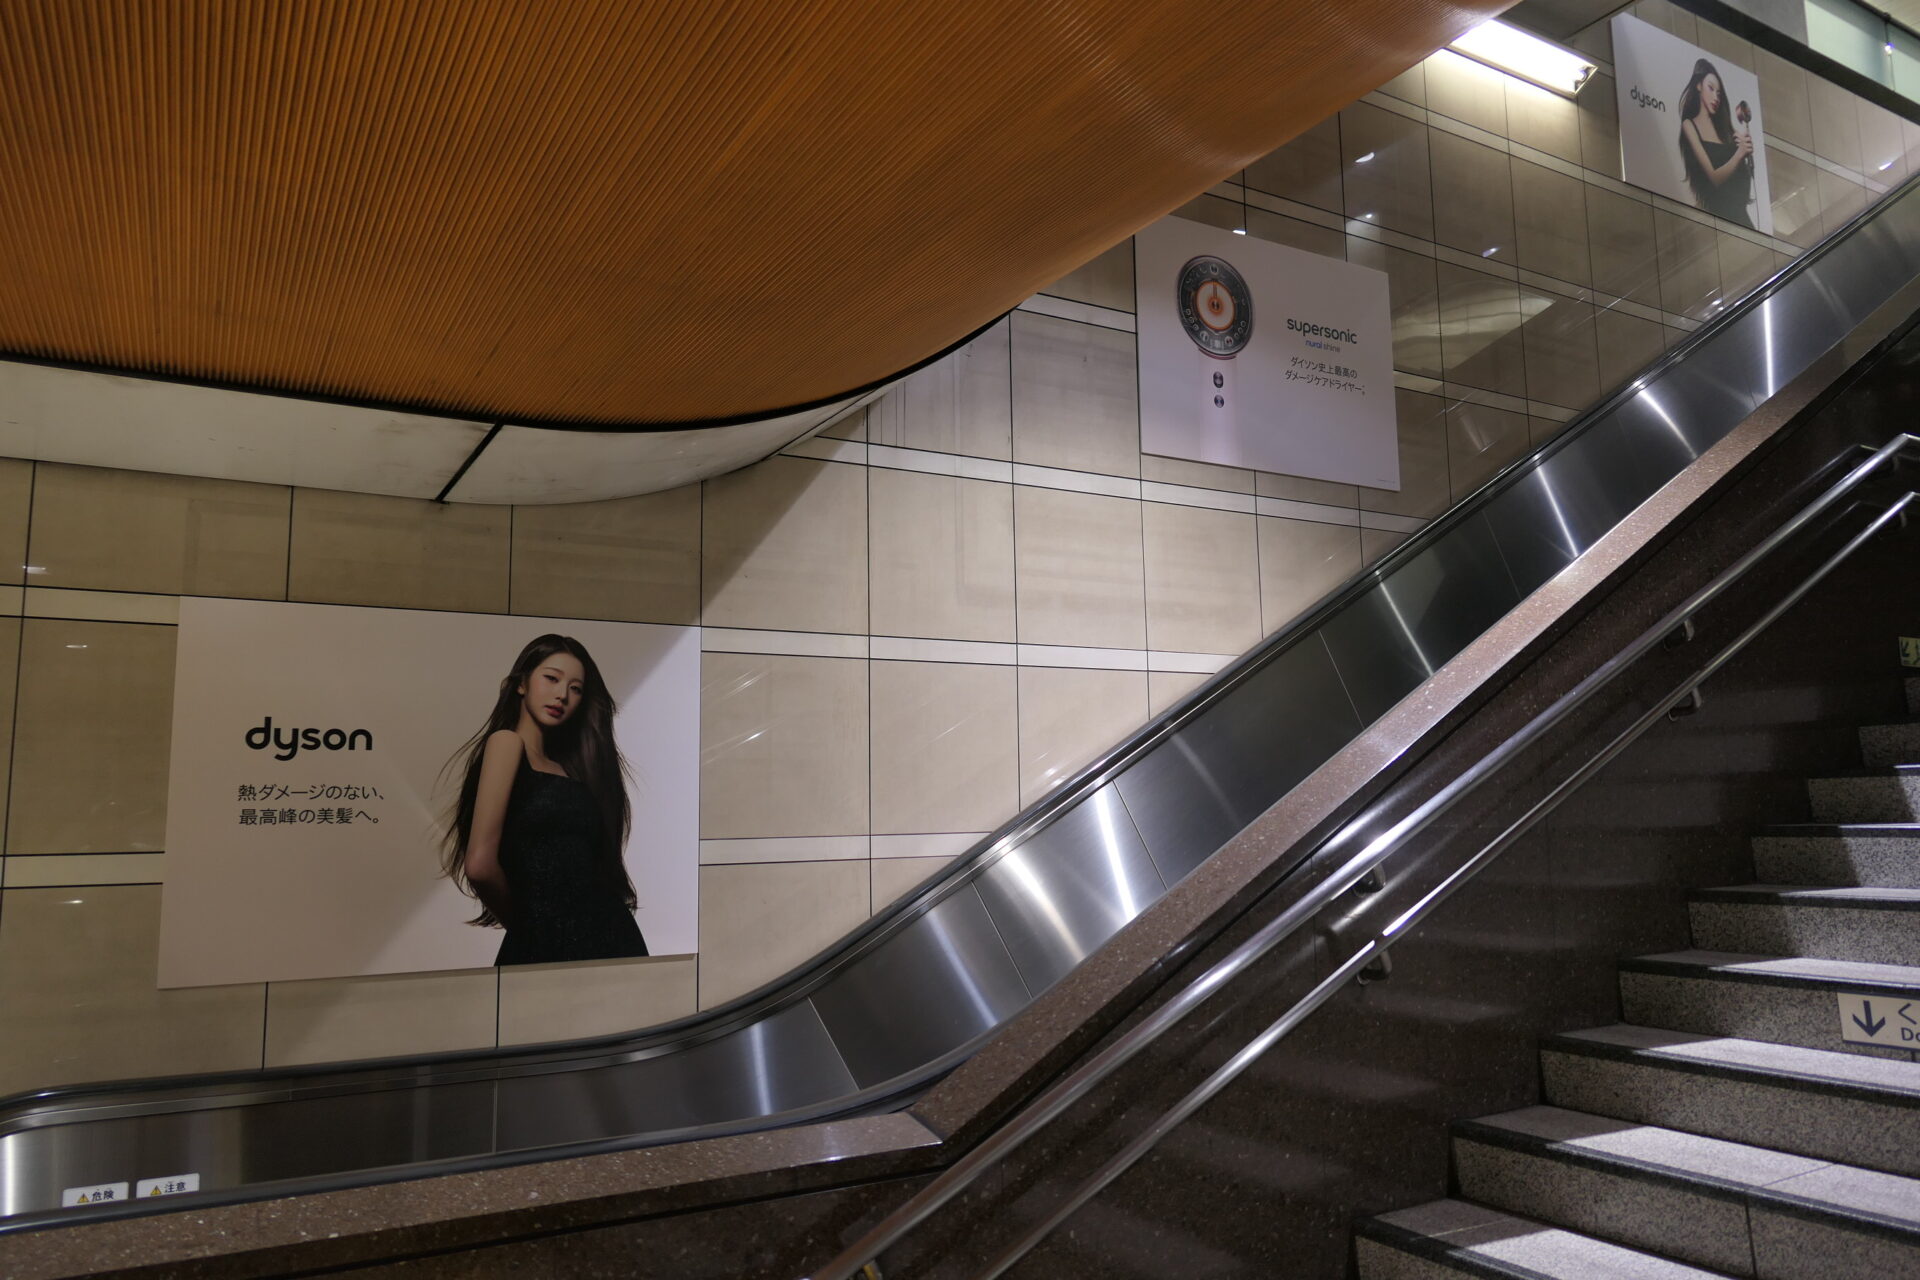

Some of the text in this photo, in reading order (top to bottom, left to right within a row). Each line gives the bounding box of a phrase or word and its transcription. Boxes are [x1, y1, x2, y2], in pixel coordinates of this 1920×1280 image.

[1630, 85, 1666, 112] dyson
[1286, 318, 1358, 344] supersonic
[1290, 356, 1358, 379] ダイソン史上最高の
[245, 716, 373, 762] dyson
[237, 784, 385, 802] 熱ダメージのない、
[238, 807, 380, 826] 最高峰の美髪へ。
[91, 1189, 115, 1202] 危険
[164, 1181, 187, 1193] 注意
